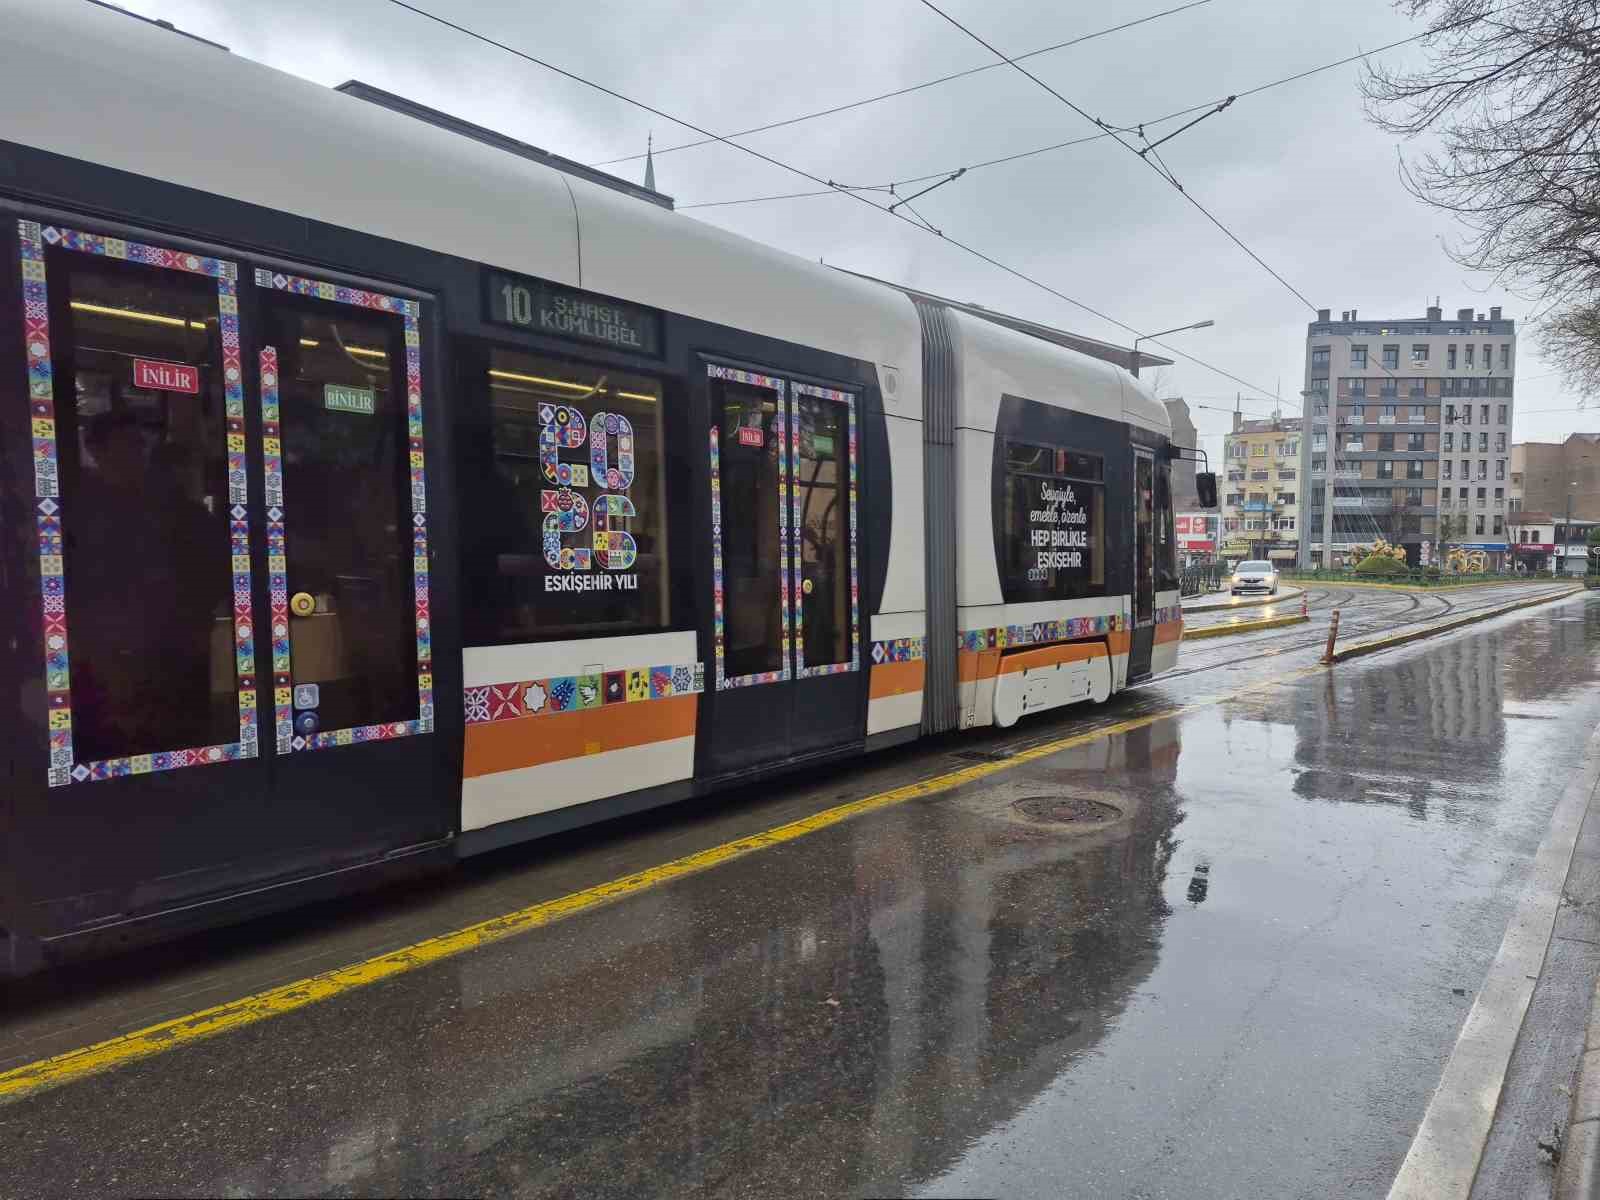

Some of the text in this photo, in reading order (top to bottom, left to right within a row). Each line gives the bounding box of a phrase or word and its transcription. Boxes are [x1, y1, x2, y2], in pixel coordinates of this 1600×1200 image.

[502, 284, 532, 325] 10
[143, 364, 191, 389] İNİLİR
[327, 390, 372, 409] BİNİLİR
[538, 402, 634, 490] 20
[1031, 526, 1087, 547] HEP BİRLİKLE
[1037, 547, 1082, 571] ESKİŞEHİR
[544, 571, 638, 593] ESKİŞEHİR YILI
